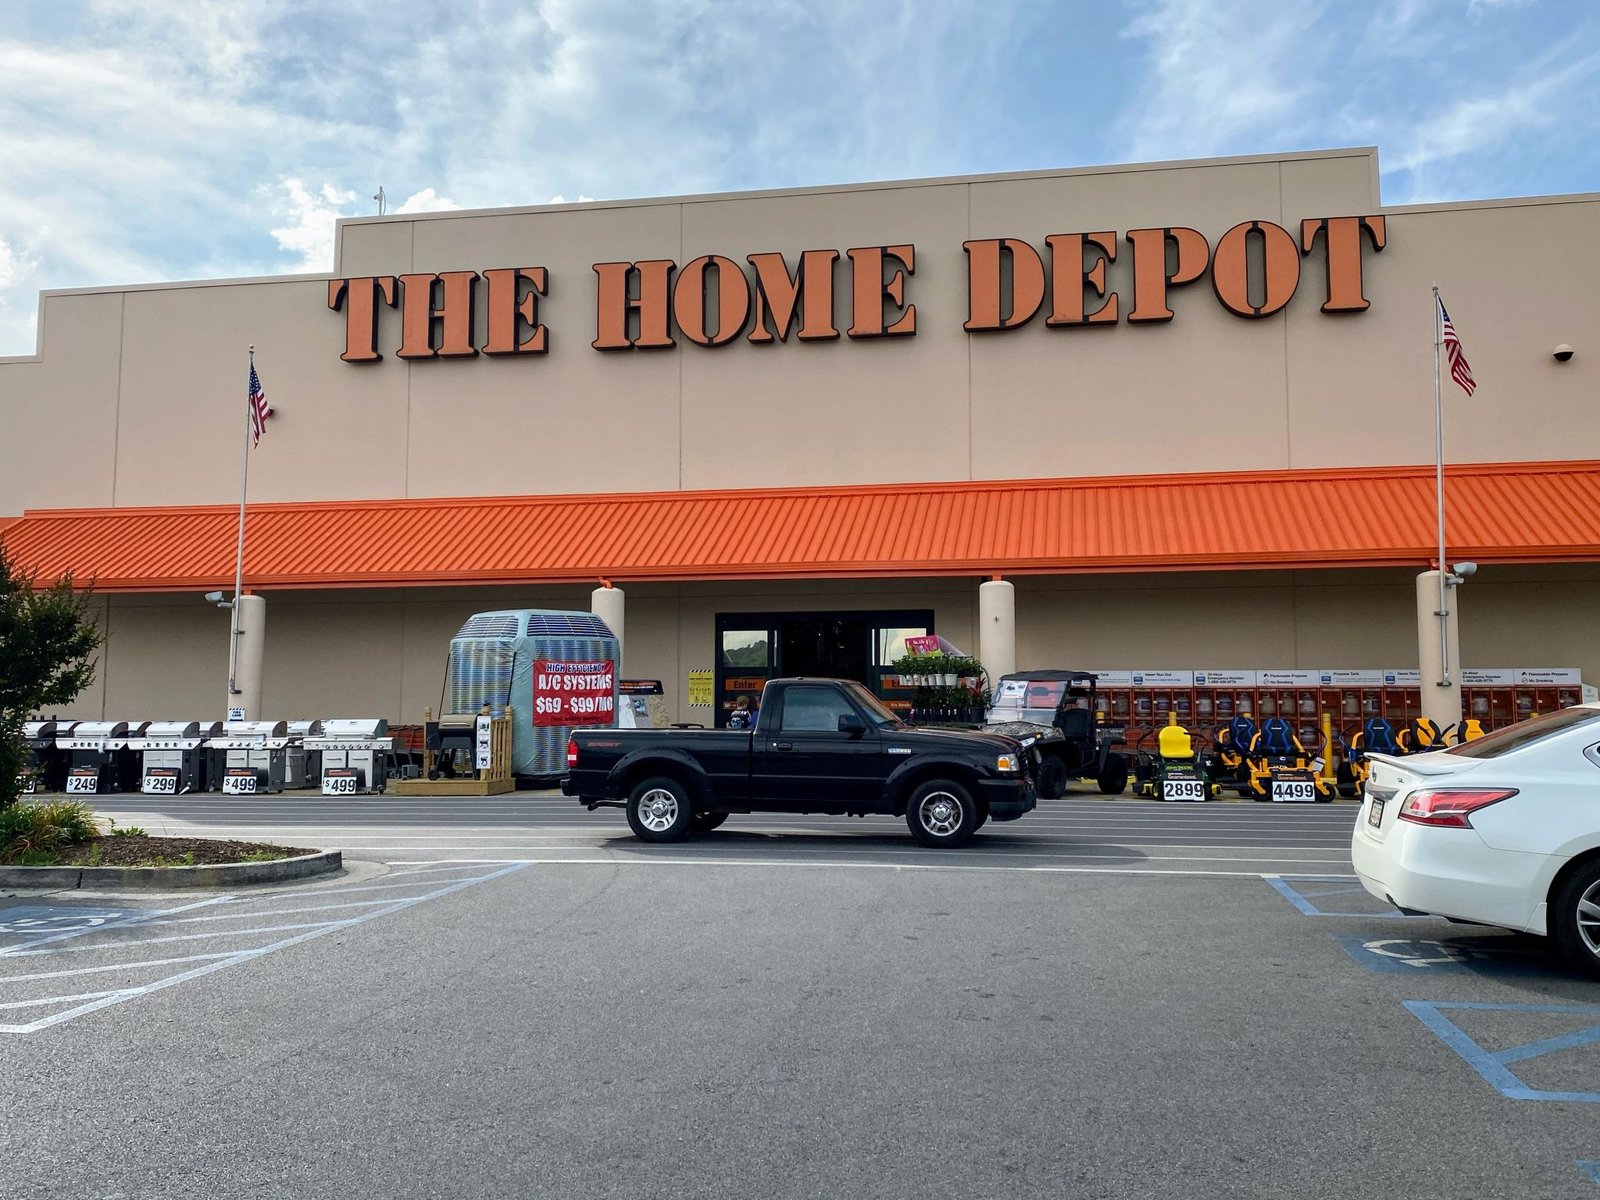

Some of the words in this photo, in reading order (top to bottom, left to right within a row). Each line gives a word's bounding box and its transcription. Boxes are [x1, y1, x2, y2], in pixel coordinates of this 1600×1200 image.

[329, 267, 549, 363] THE
[591, 244, 916, 351] HOME
[962, 215, 1386, 332] DEPOT
[546, 663, 566, 672] HIGH
[567, 663, 605, 673] EFFICIENCY
[538, 674, 562, 690] A/C
[563, 674, 612, 690] SYSTEMS
[733, 681, 756, 689] Enter
[536, 696, 562, 714] $69
[570, 696, 613, 714] $99/MO
[1165, 783, 1204, 797] 2899
[1274, 784, 1314, 798] 4499
